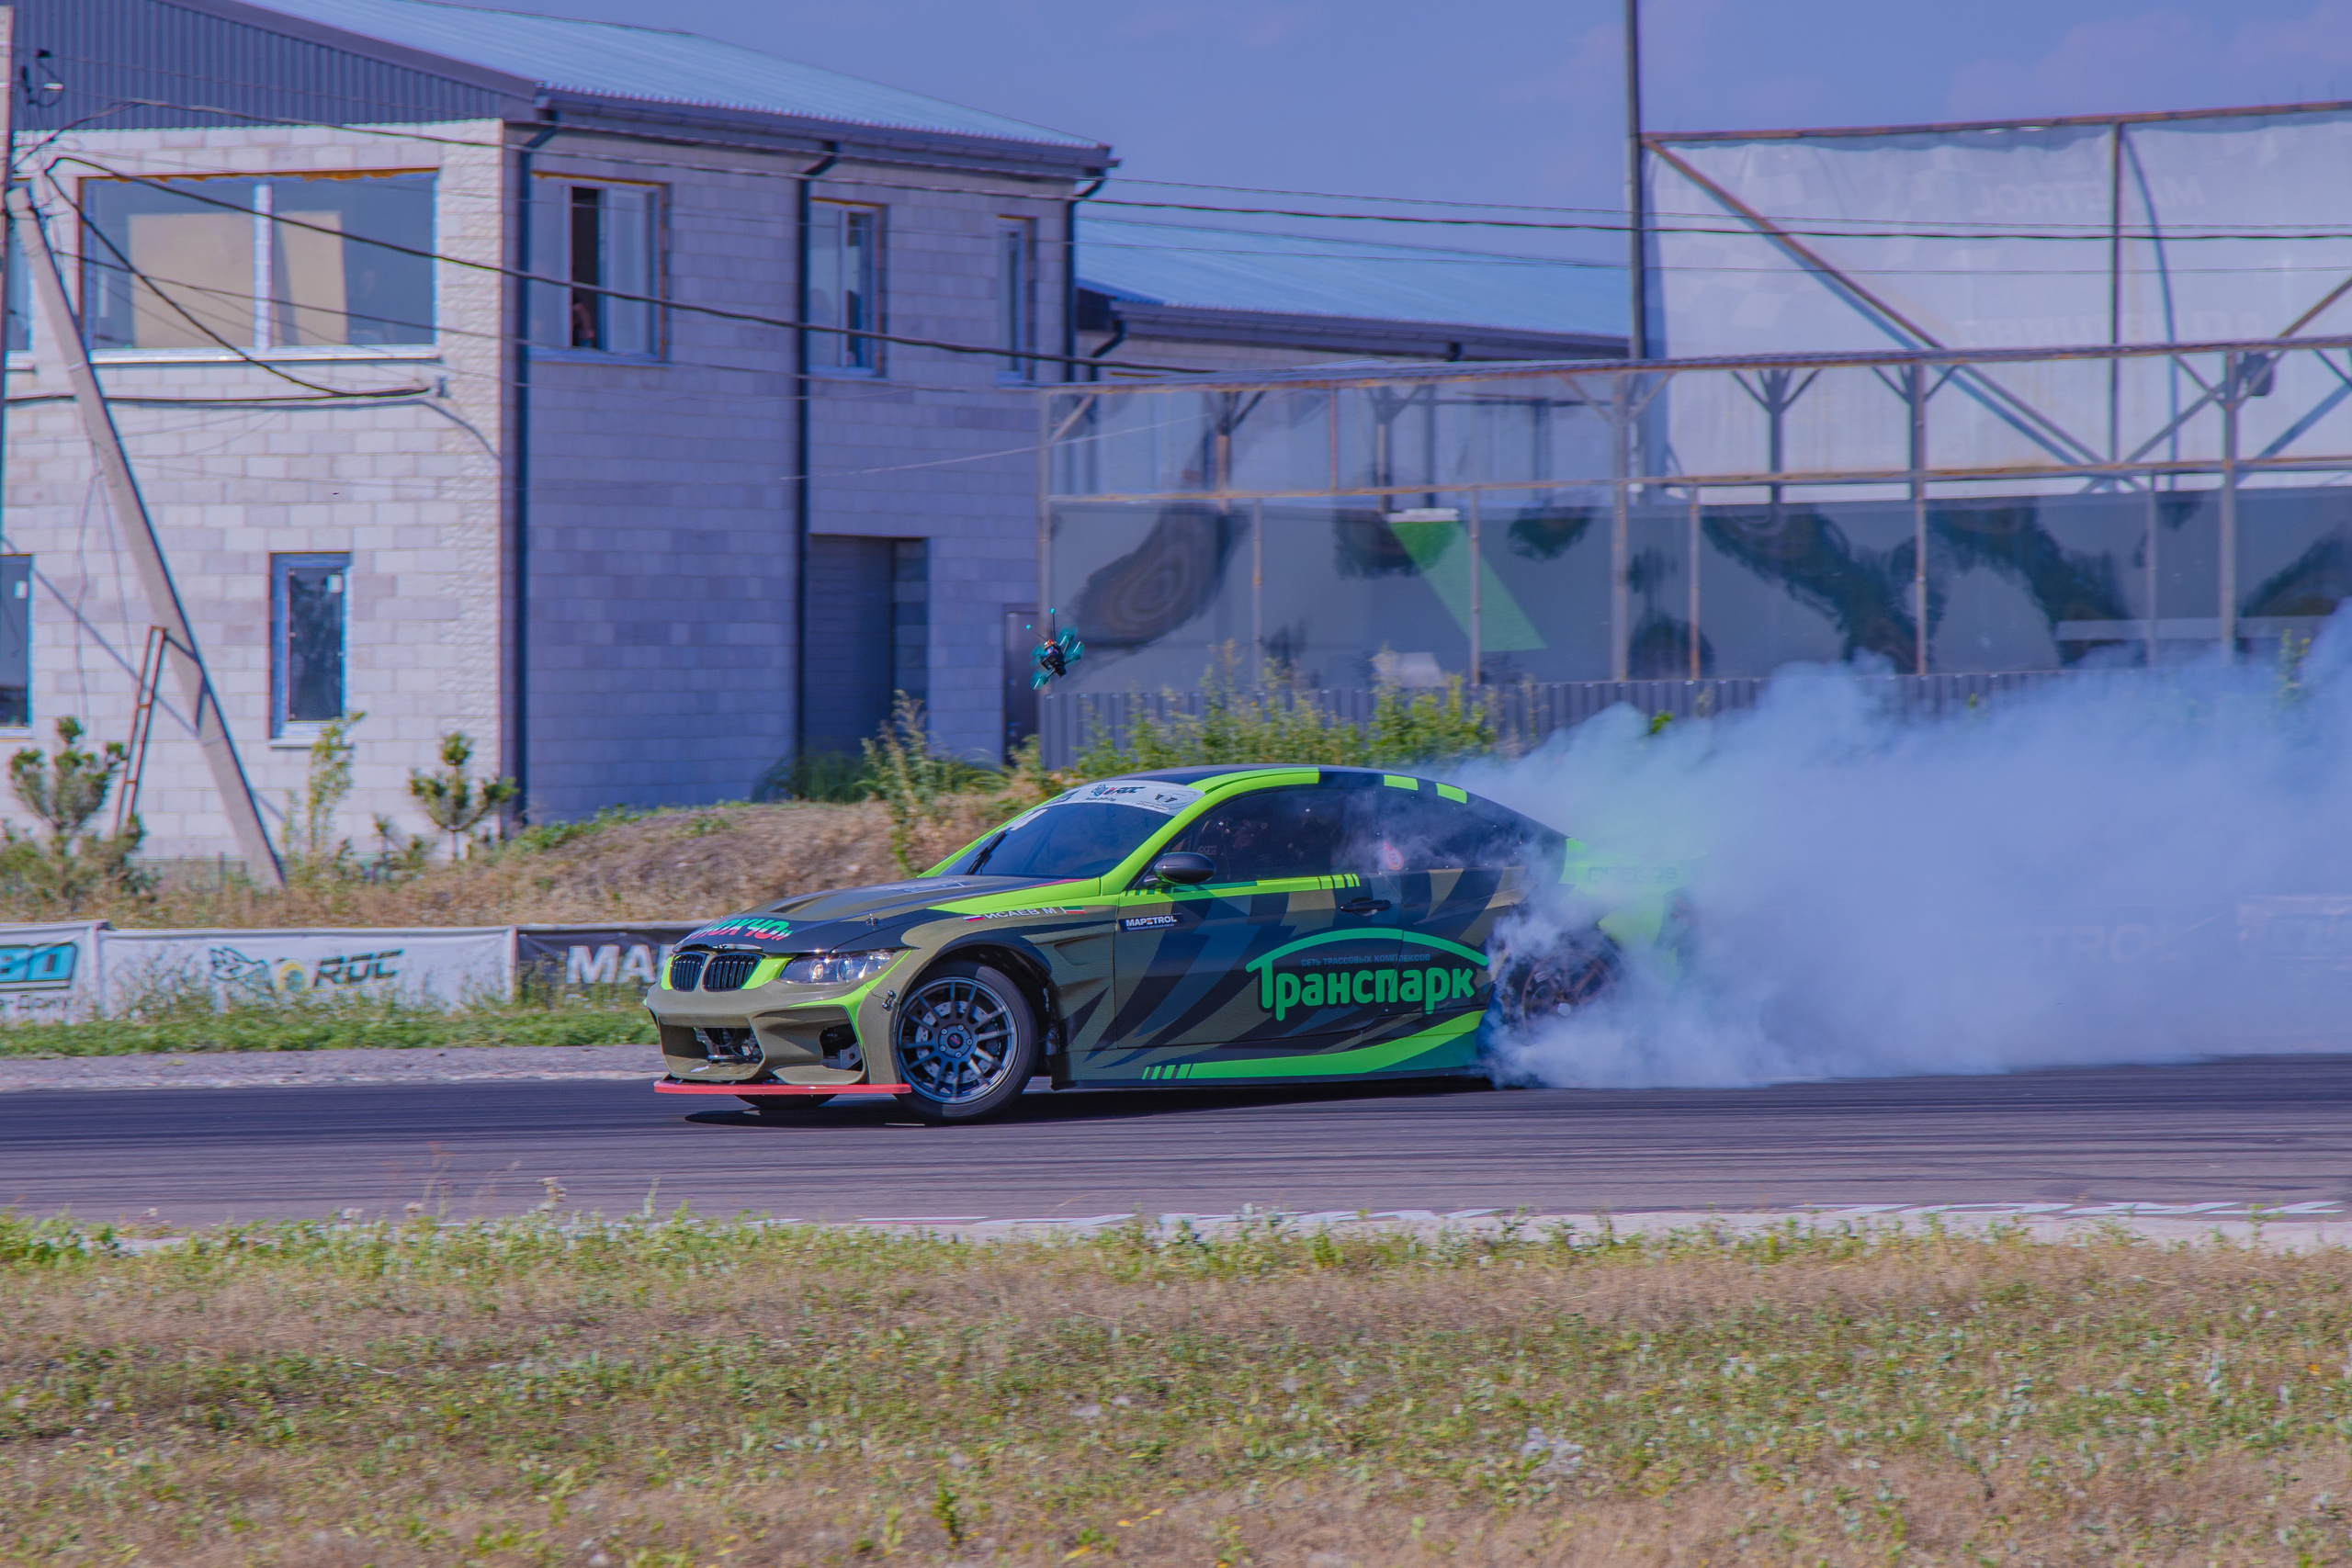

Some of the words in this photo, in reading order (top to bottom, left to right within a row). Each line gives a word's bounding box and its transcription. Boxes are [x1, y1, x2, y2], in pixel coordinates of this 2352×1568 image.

[983, 907, 1041, 919] ИСАЕВ
[1043, 906, 1057, 916] М
[1125, 915, 1177, 927] MAPETROL
[1300, 958, 1321, 967] СЕТЬ
[1323, 955, 1373, 965] ТРАССОВЫХ
[1374, 953, 1431, 963] КОМПЛЕКСОВ
[1245, 928, 1488, 1021] Транспарк
